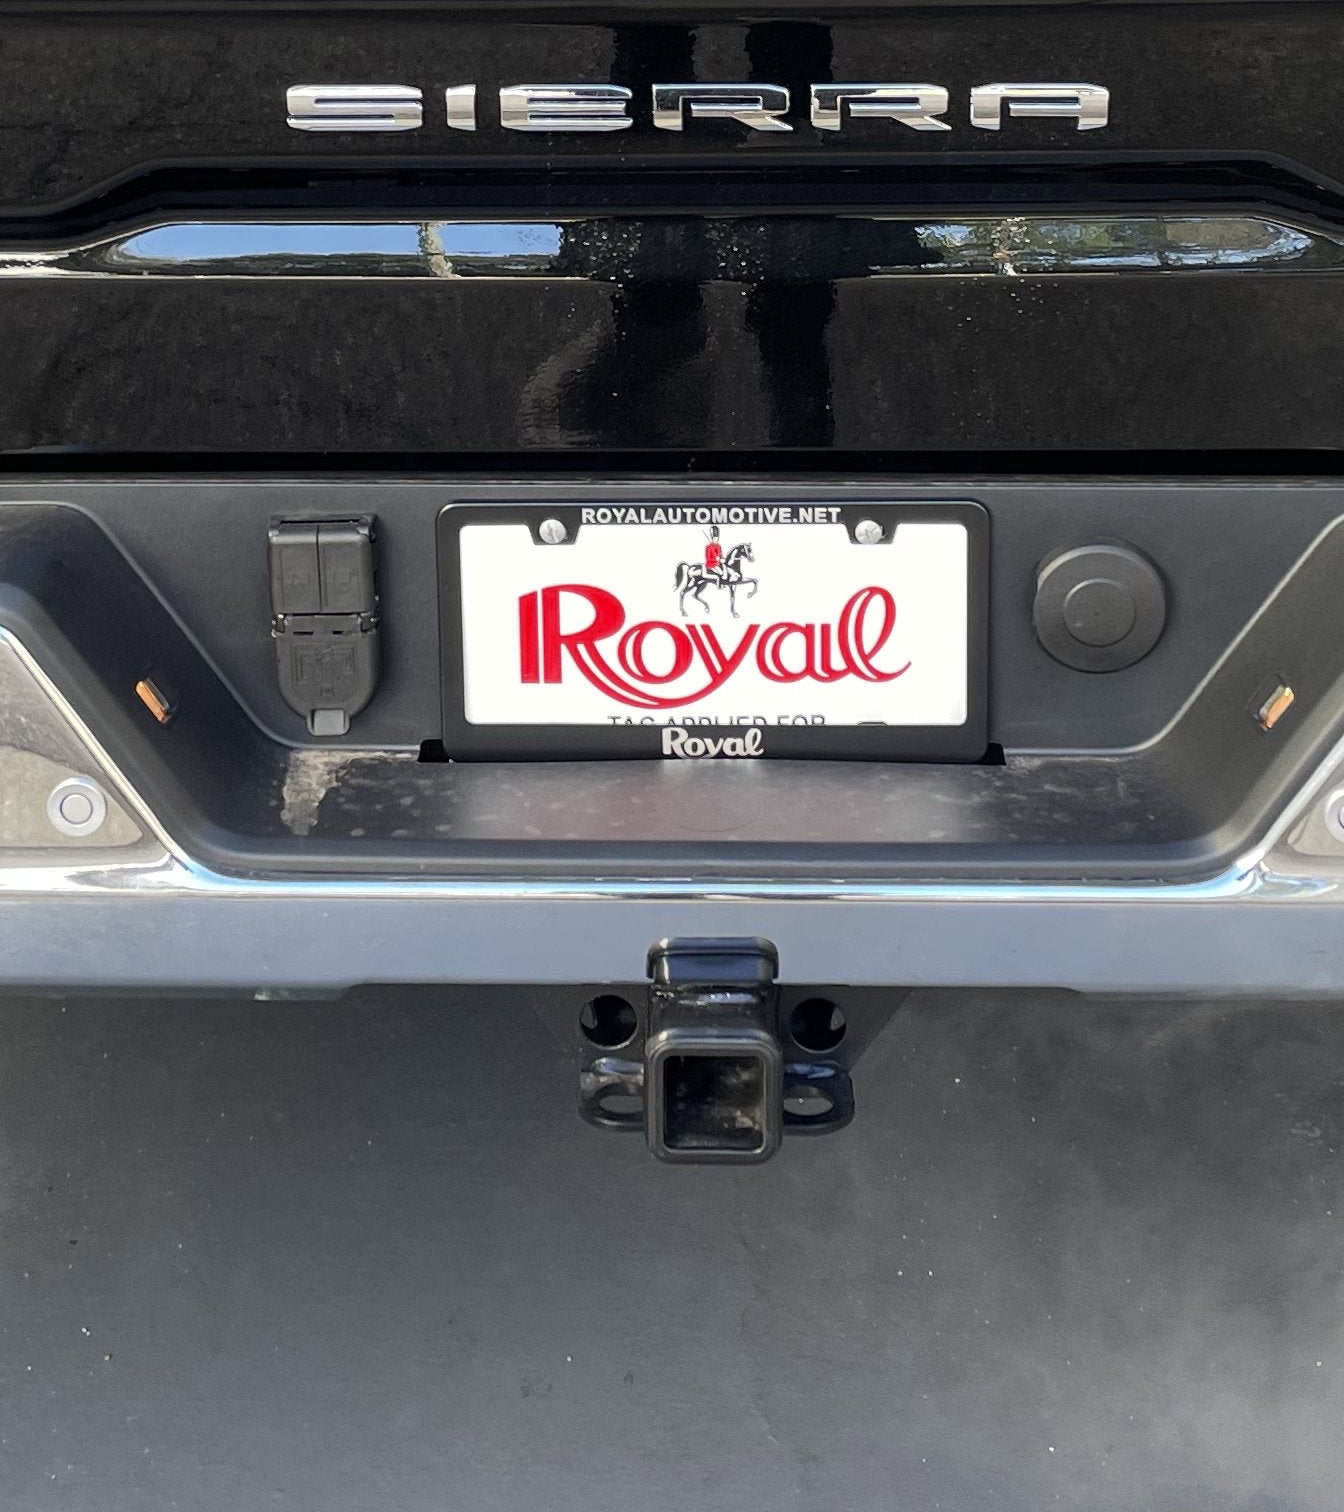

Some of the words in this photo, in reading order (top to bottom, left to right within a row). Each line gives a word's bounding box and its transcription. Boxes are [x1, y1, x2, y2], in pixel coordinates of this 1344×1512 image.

[285, 82, 1112, 133] SIERRA
[580, 506, 842, 524] ROYALAUTOMOTIVE.NET
[517, 583, 913, 710] Royal
[661, 726, 765, 760] Royal
